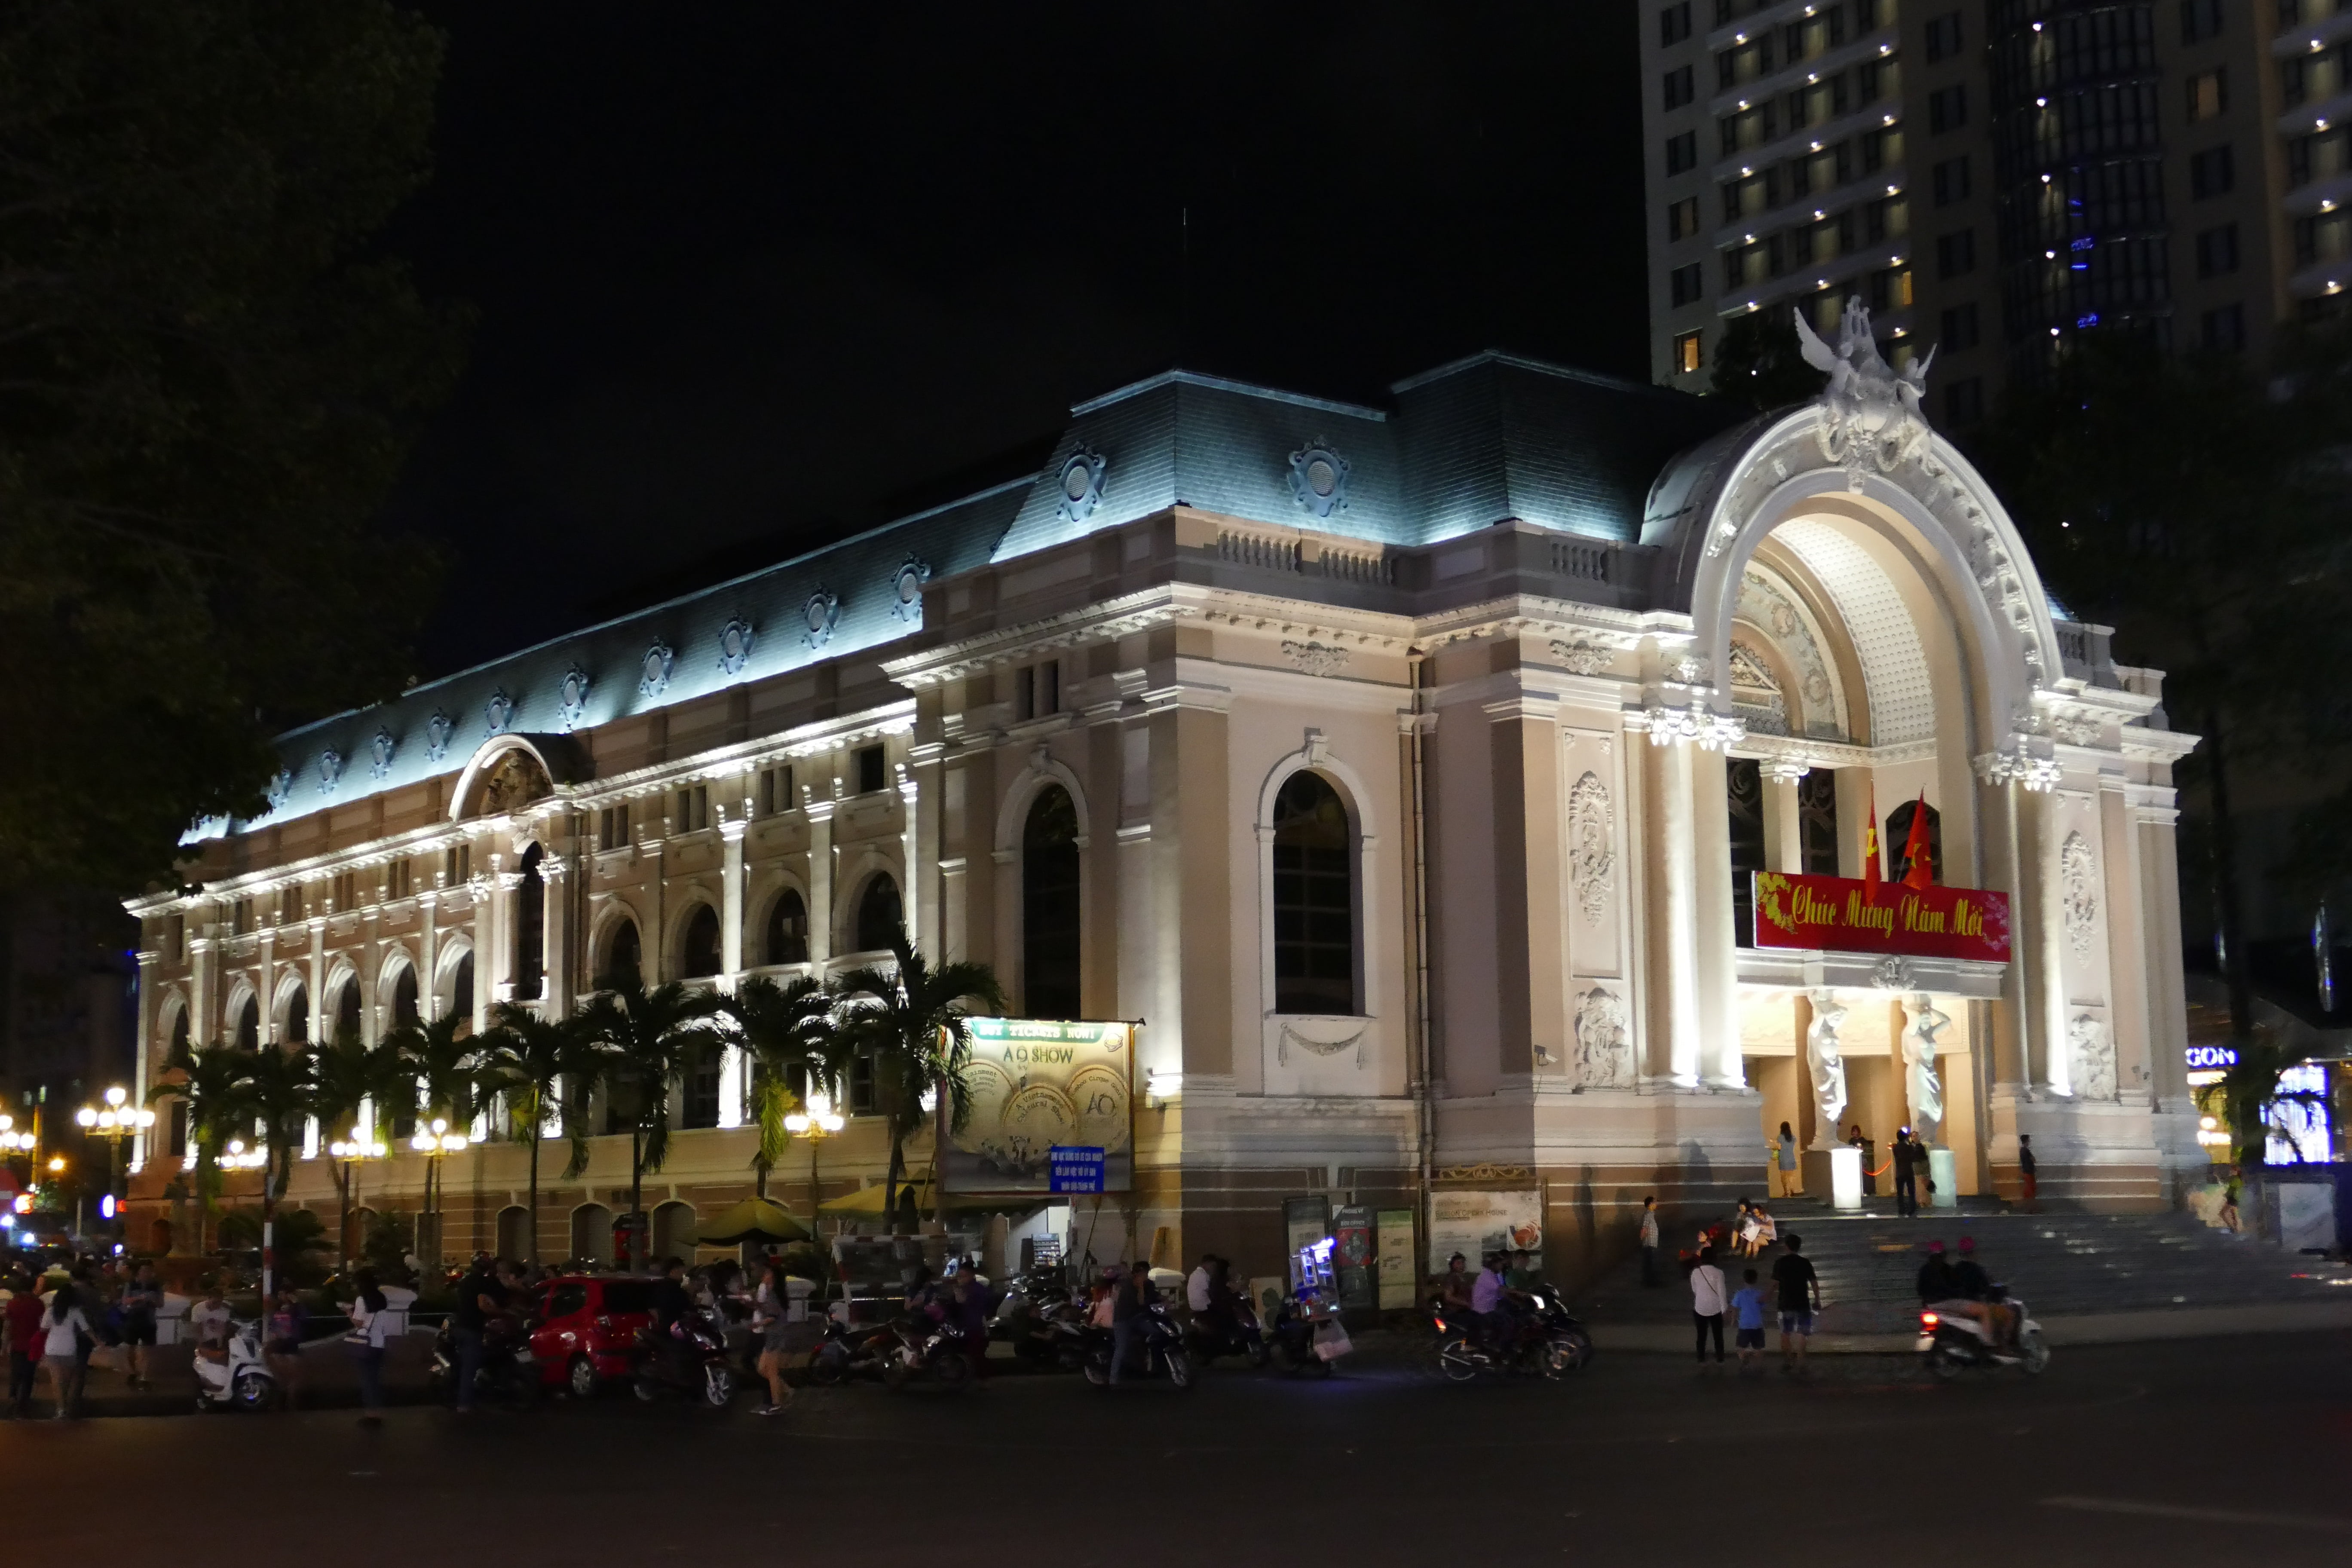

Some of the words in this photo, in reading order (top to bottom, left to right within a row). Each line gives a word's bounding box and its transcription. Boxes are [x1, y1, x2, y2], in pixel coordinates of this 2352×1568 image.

[1792, 885, 1837, 925] Chúc
[1900, 894, 1946, 933] Năm
[1950, 897, 1983, 936] Mới
[979, 1024, 1003, 1036] BUY
[1009, 1025, 1061, 1038] TICKETS
[1067, 1027, 1095, 1039] NOW!
[1032, 1046, 1074, 1064] SHOW
